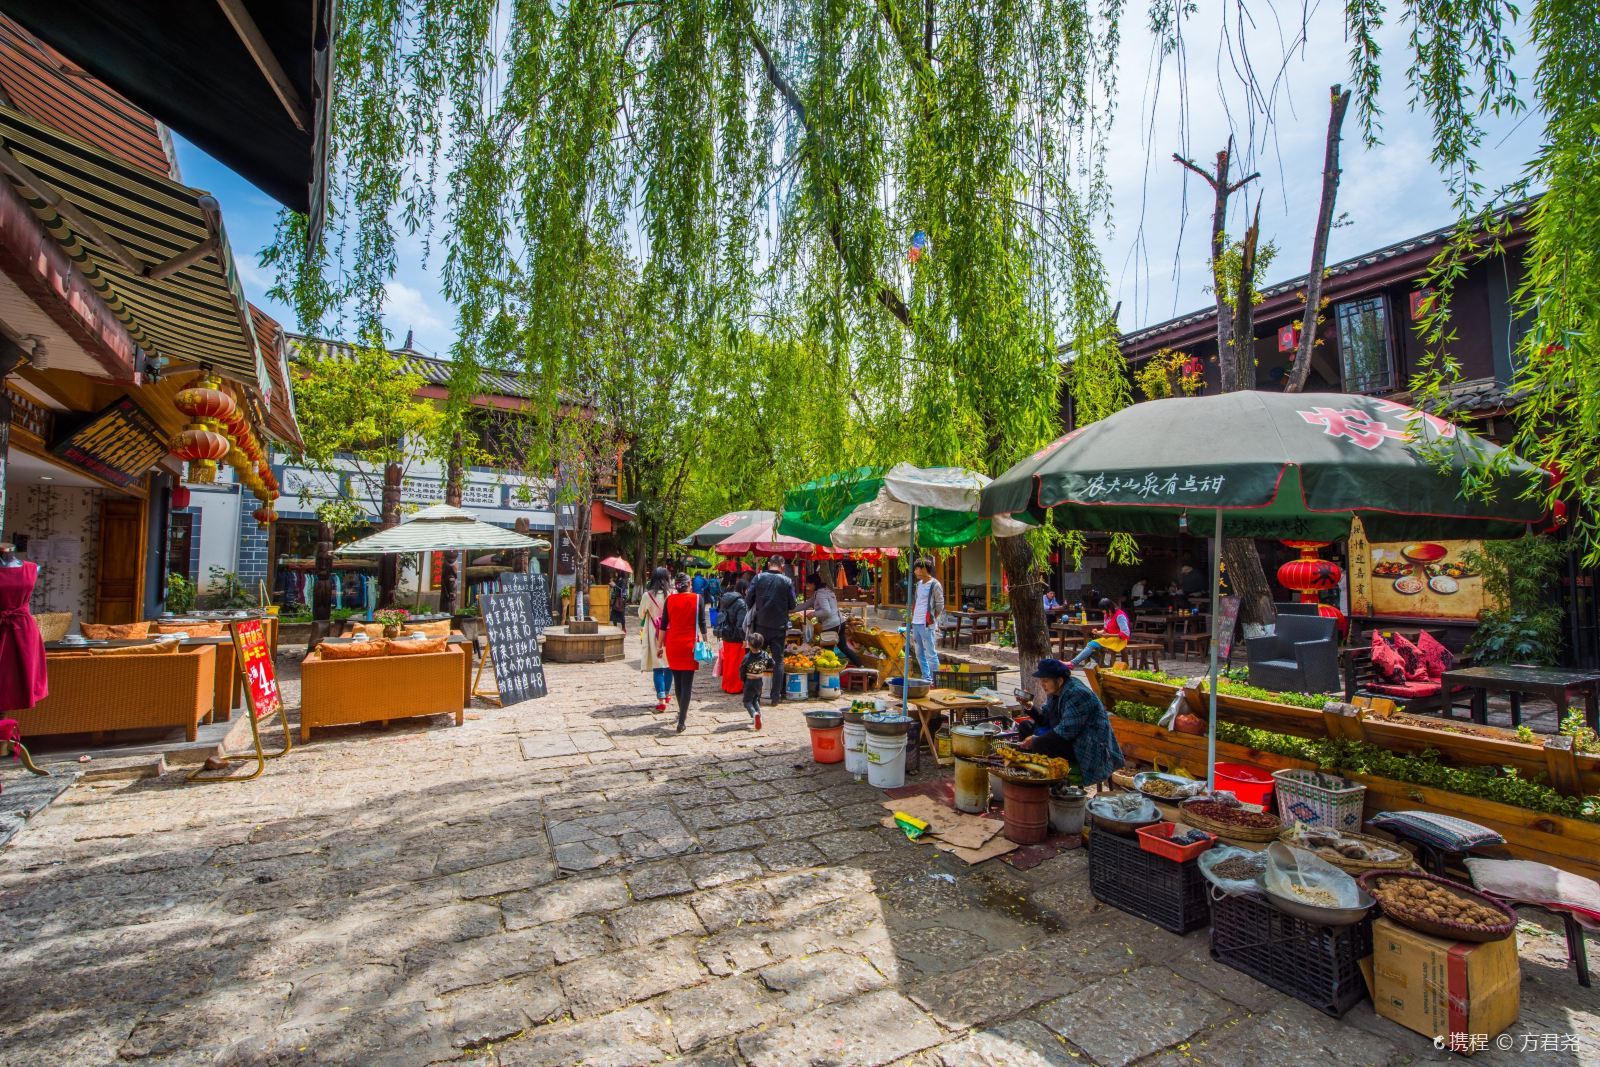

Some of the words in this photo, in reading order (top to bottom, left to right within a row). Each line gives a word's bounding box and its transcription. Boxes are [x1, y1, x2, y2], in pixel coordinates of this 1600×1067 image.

[1078, 472, 1226, 498] 农夫山泉有点甜
